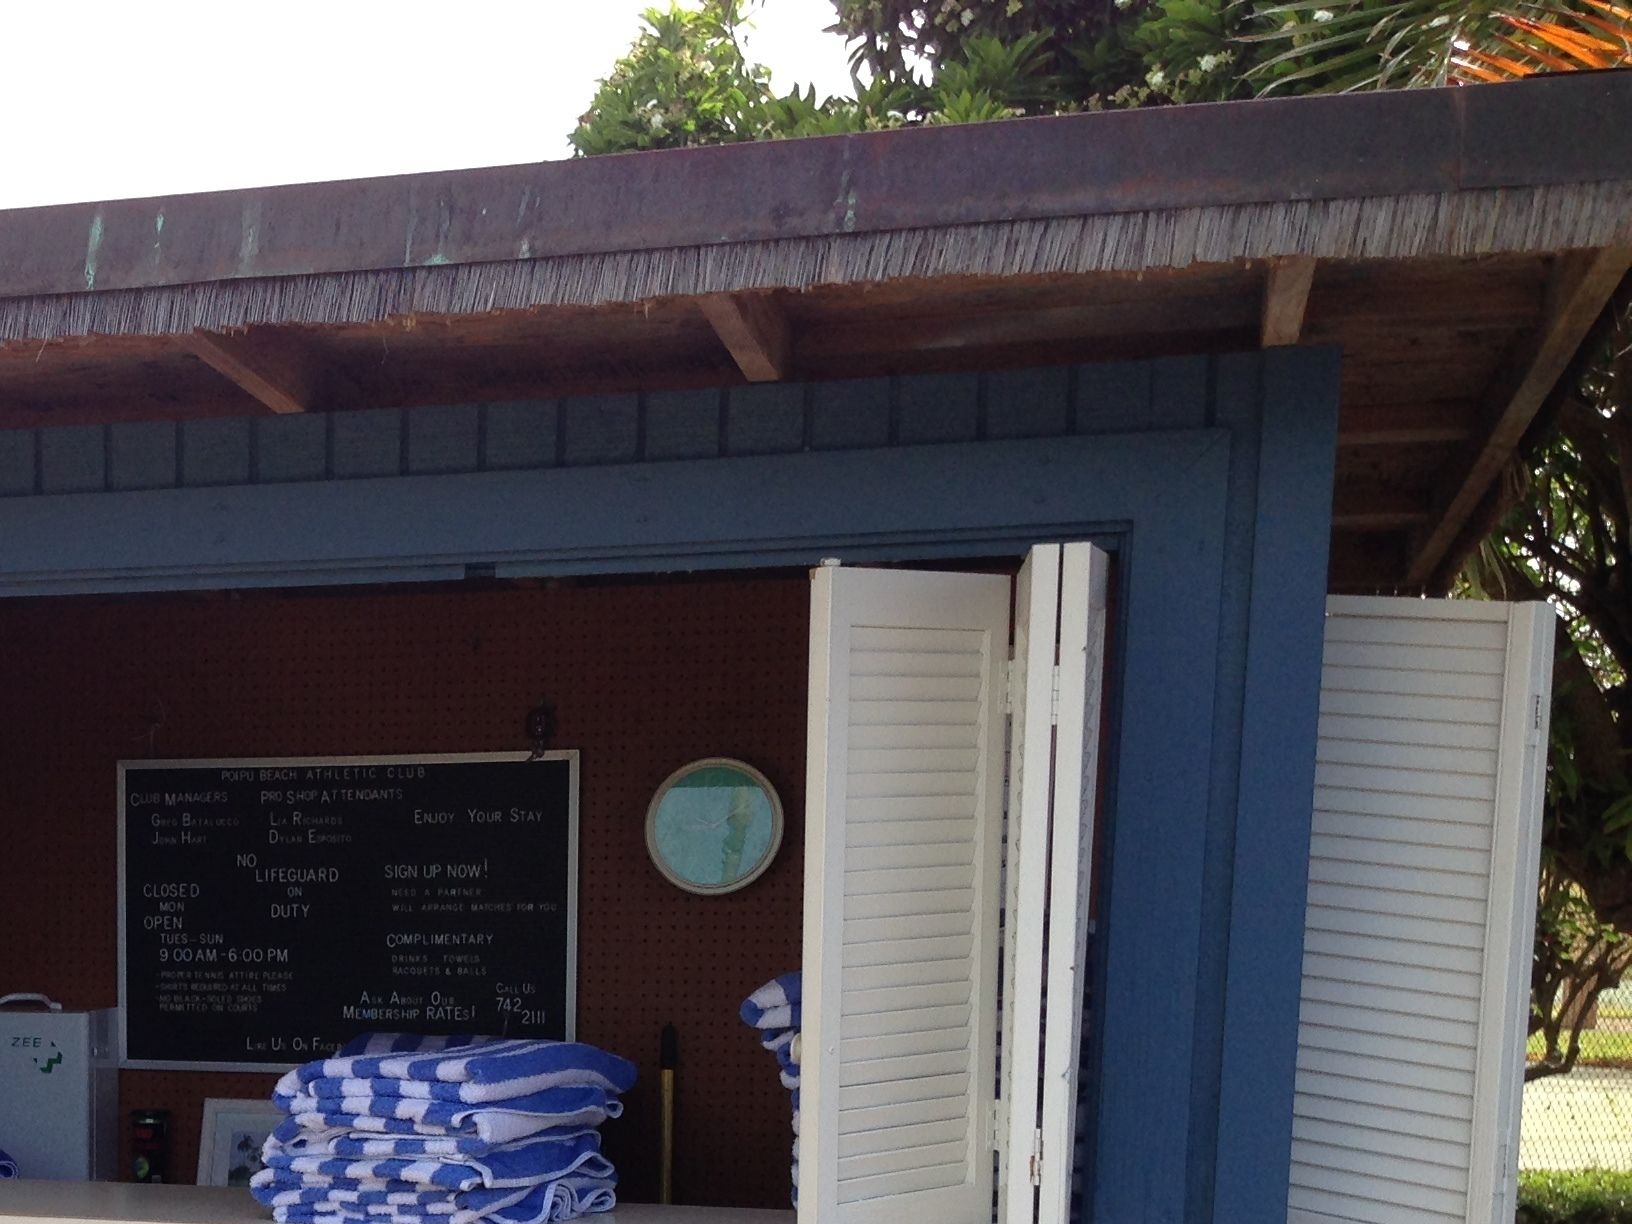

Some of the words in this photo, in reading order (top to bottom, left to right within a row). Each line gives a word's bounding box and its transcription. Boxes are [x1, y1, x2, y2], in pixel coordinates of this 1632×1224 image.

[221, 769, 254, 782] POIPU
[259, 769, 297, 781] BEACH
[306, 767, 376, 780] ATHLETIC
[386, 767, 426, 778] CLUB
[130, 793, 160, 807] CLUB
[164, 792, 228, 806] MANAGERS
[320, 788, 403, 803] ATTENDANTS
[236, 854, 257, 868] NO
[255, 868, 339, 882] LIFEGUARD
[384, 864, 418, 879] SIGN
[423, 864, 442, 878] UP
[143, 883, 200, 898] CLOSED
[287, 887, 303, 897] ON
[159, 901, 185, 912] MON
[270, 904, 310, 919] DUTY
[143, 916, 183, 931] OPEN
[386, 933, 494, 948] COMPLIMENTARY
[495, 997, 522, 1012] 742
[343, 1005, 420, 1020] MEMBERSHIP
[521, 1010, 546, 1024] 2111
[11, 1037, 42, 1048] ZEE
